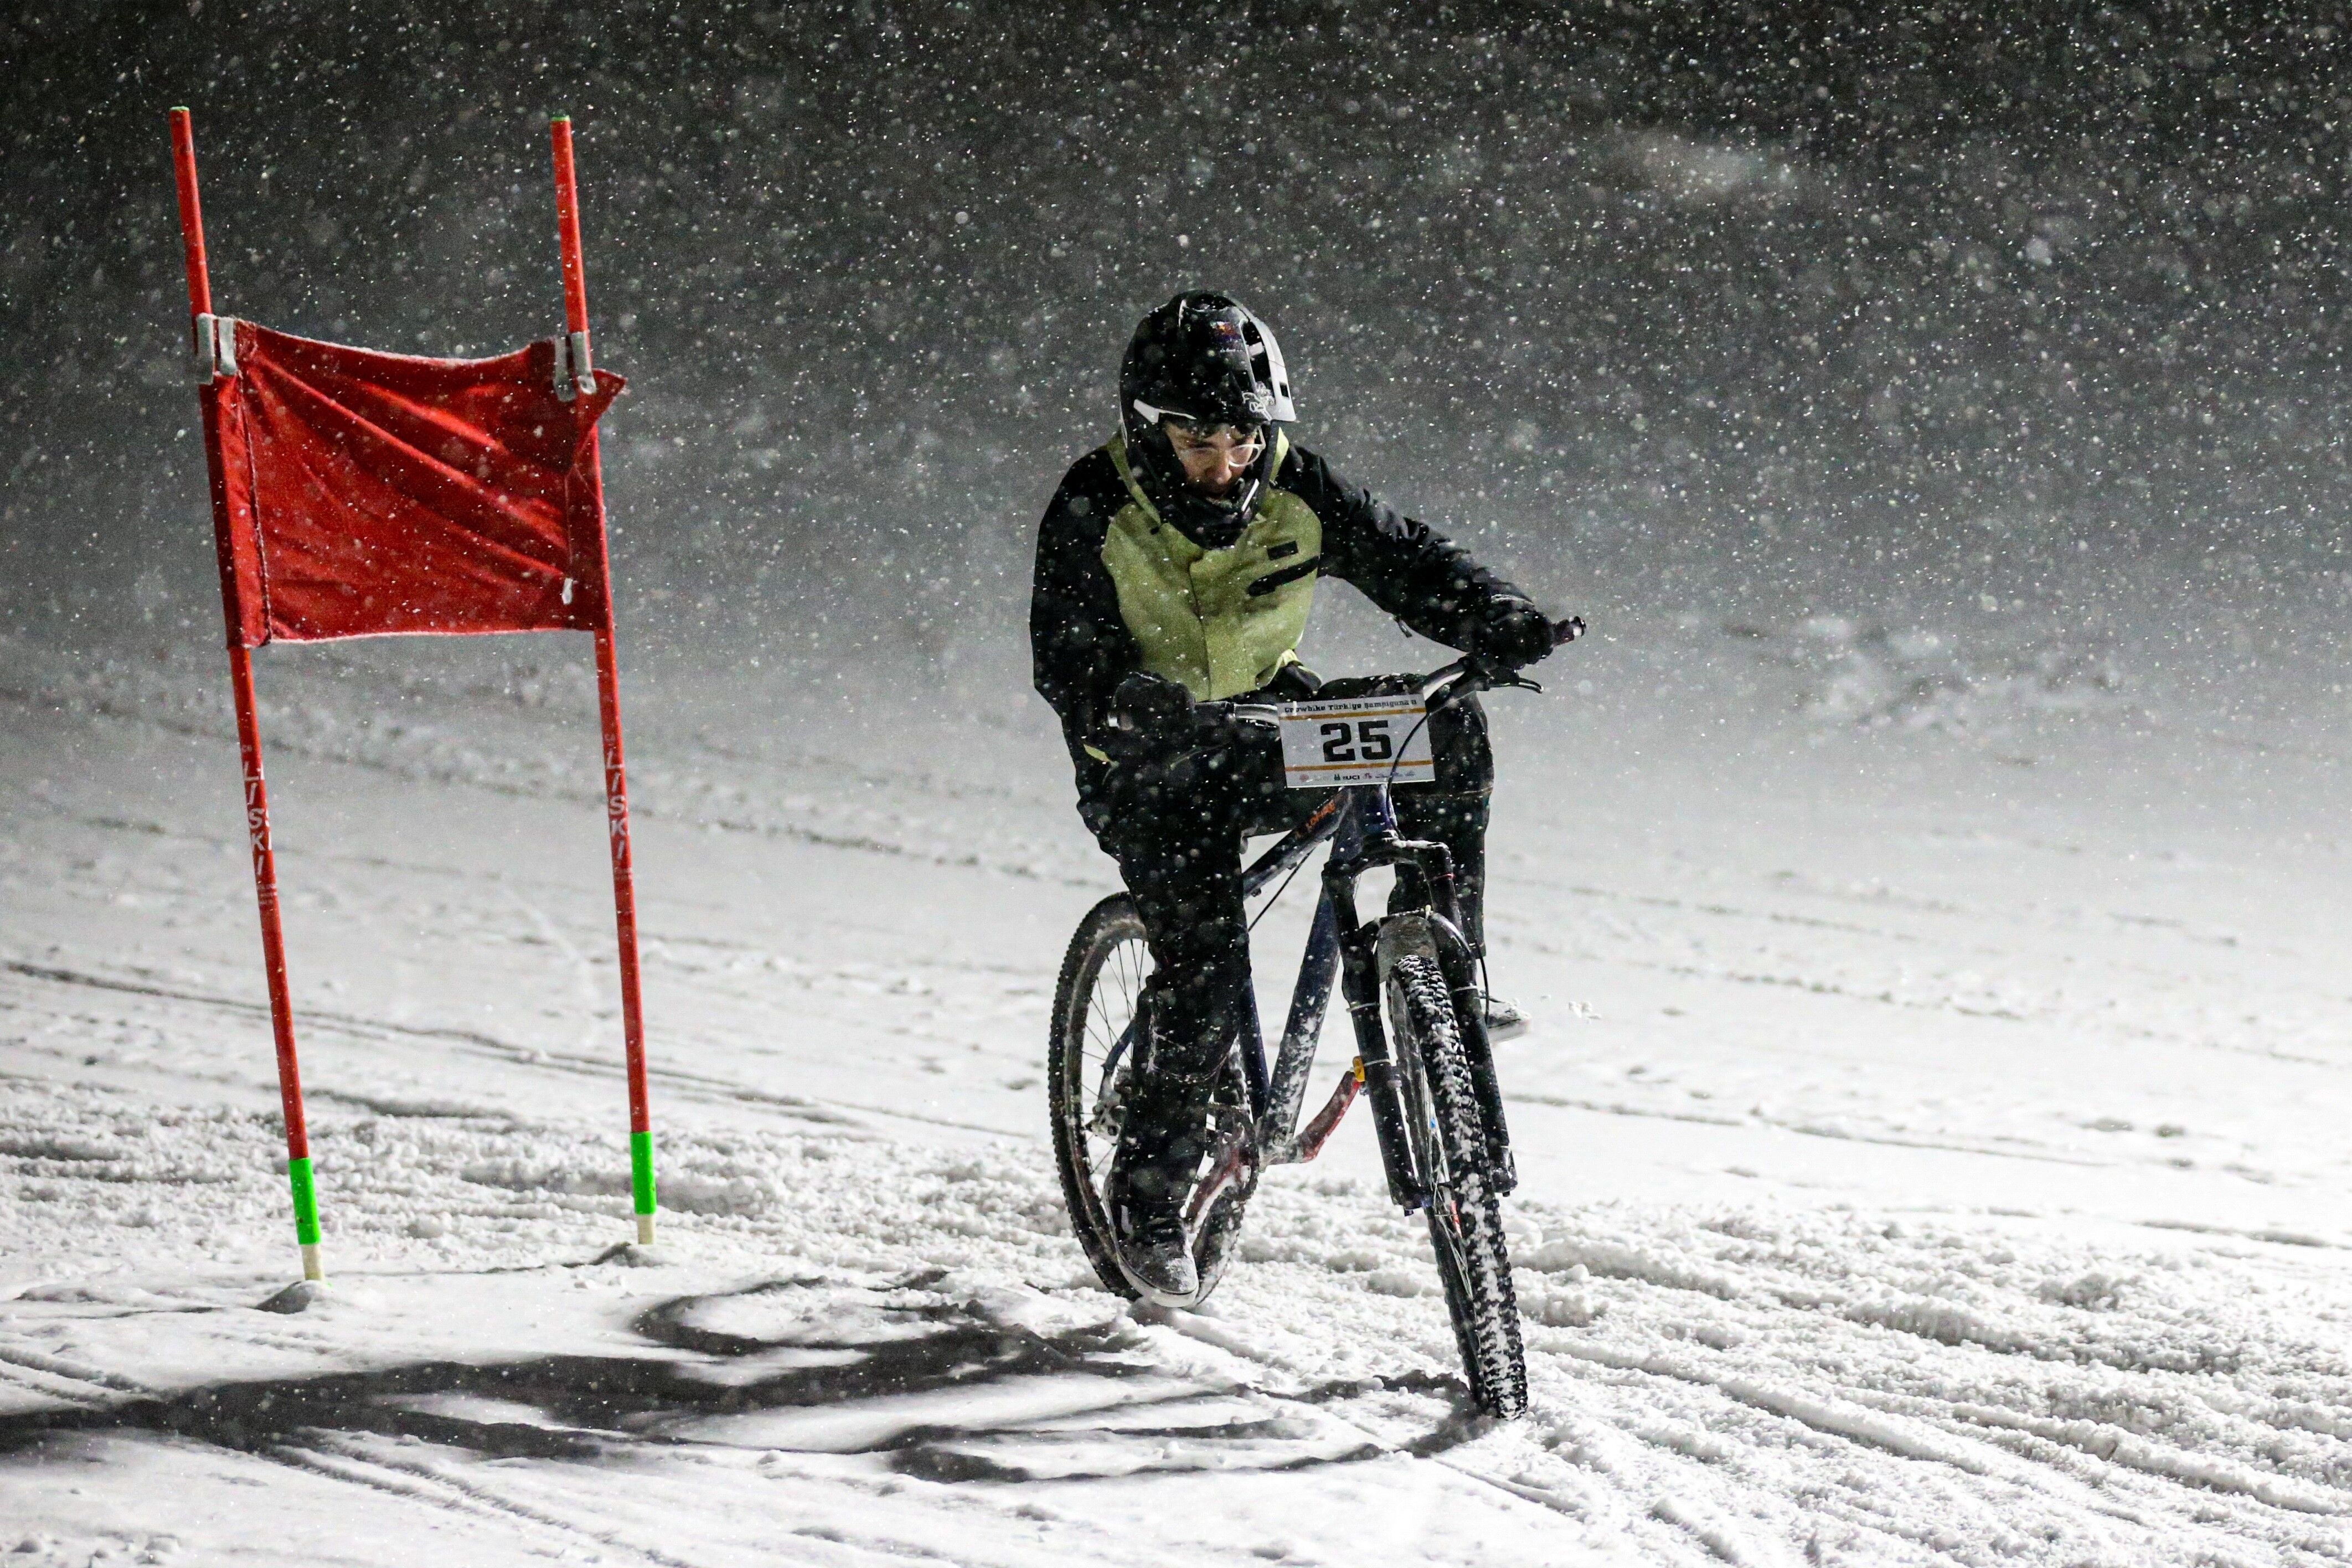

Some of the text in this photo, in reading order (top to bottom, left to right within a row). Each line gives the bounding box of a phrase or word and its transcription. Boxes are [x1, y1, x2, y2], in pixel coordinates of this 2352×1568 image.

[1321, 720, 1392, 762] 25
[243, 761, 265, 875] LISKI
[606, 749, 627, 859] LISKI
